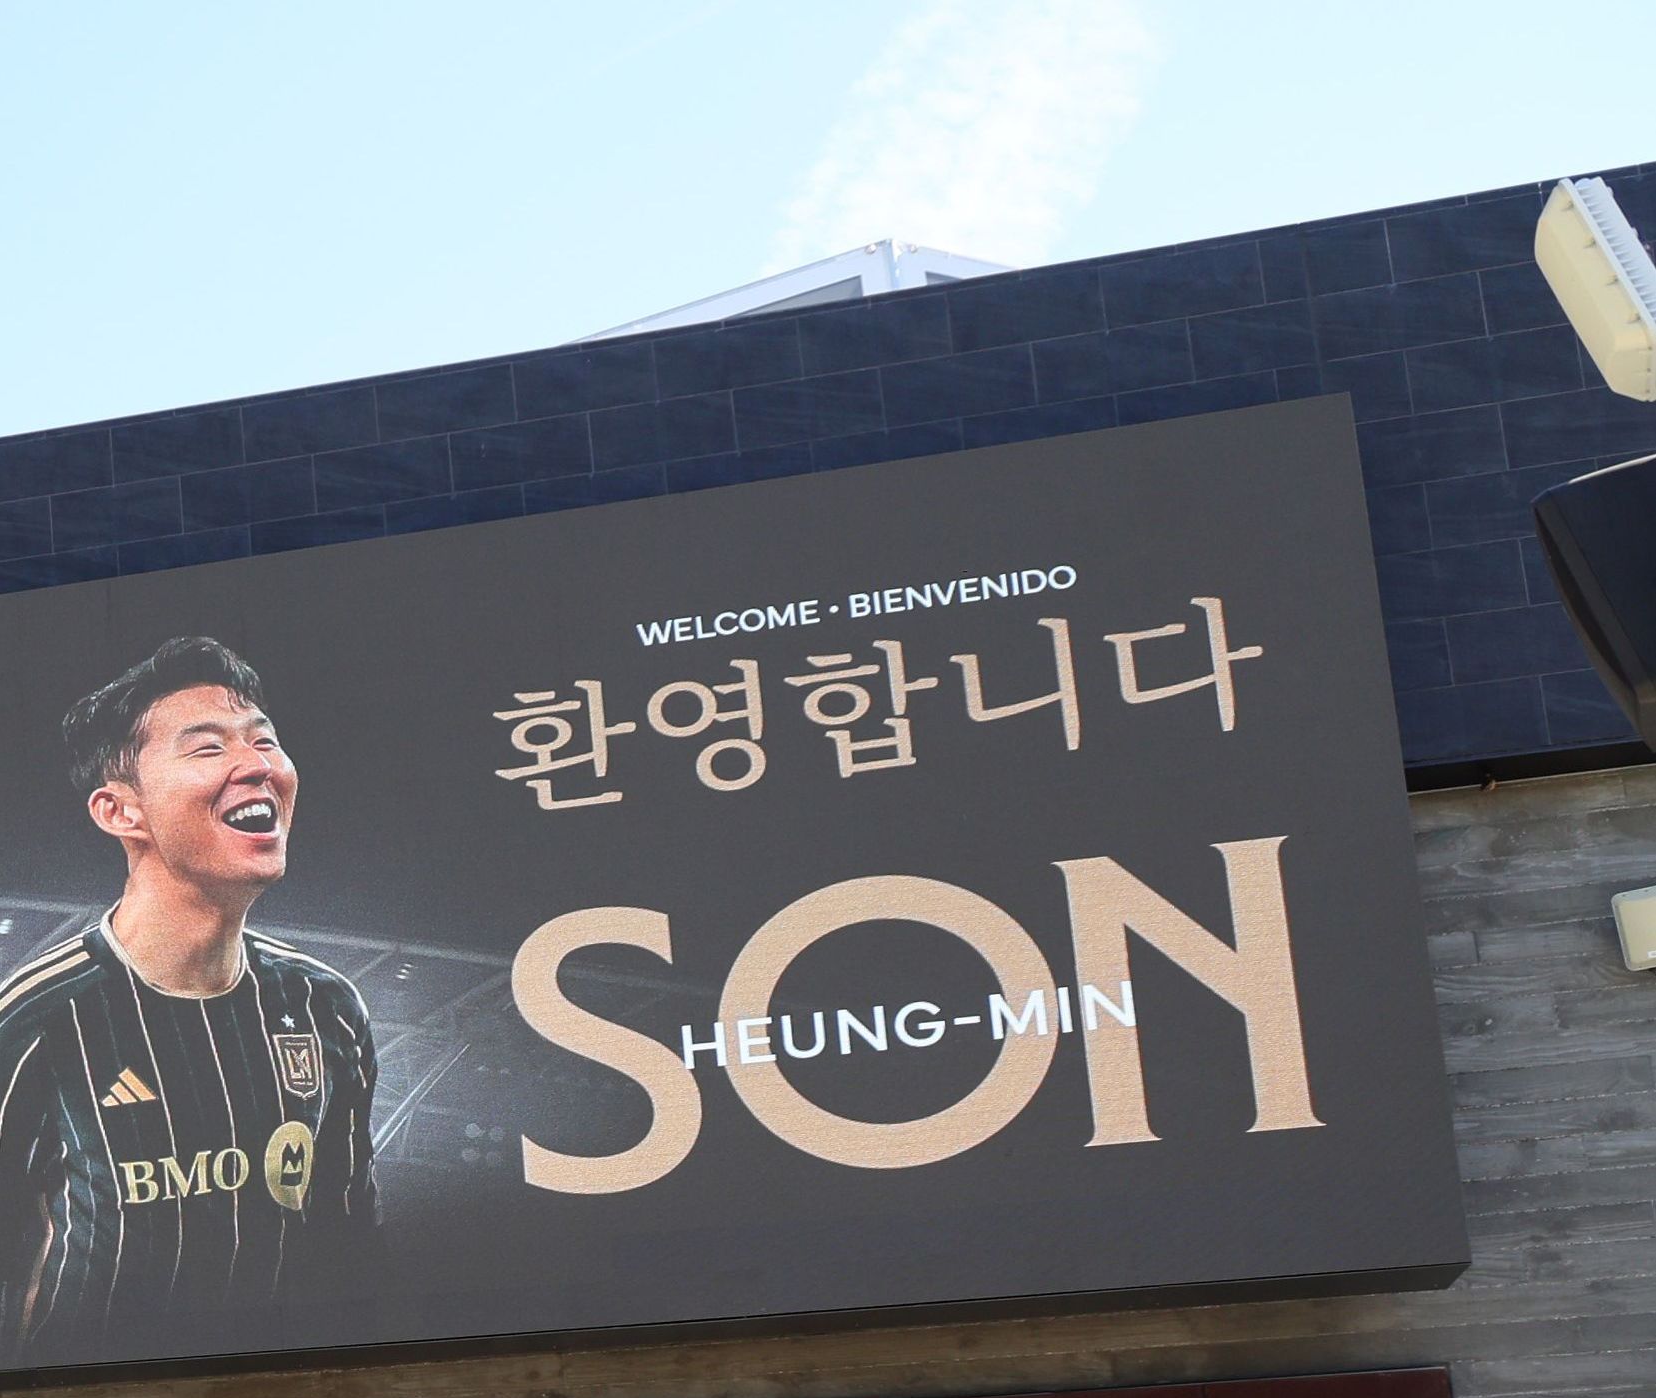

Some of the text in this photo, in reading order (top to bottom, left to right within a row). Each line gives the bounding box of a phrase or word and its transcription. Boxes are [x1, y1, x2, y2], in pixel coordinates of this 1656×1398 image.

[636, 564, 1078, 646] WELCOME BIENVENIDO
[493, 596, 1263, 811] 환영합니다
[509, 835, 1328, 1196] SON
[682, 979, 1139, 1072] HEUNG-MIN
[119, 1148, 250, 1204] BMO
